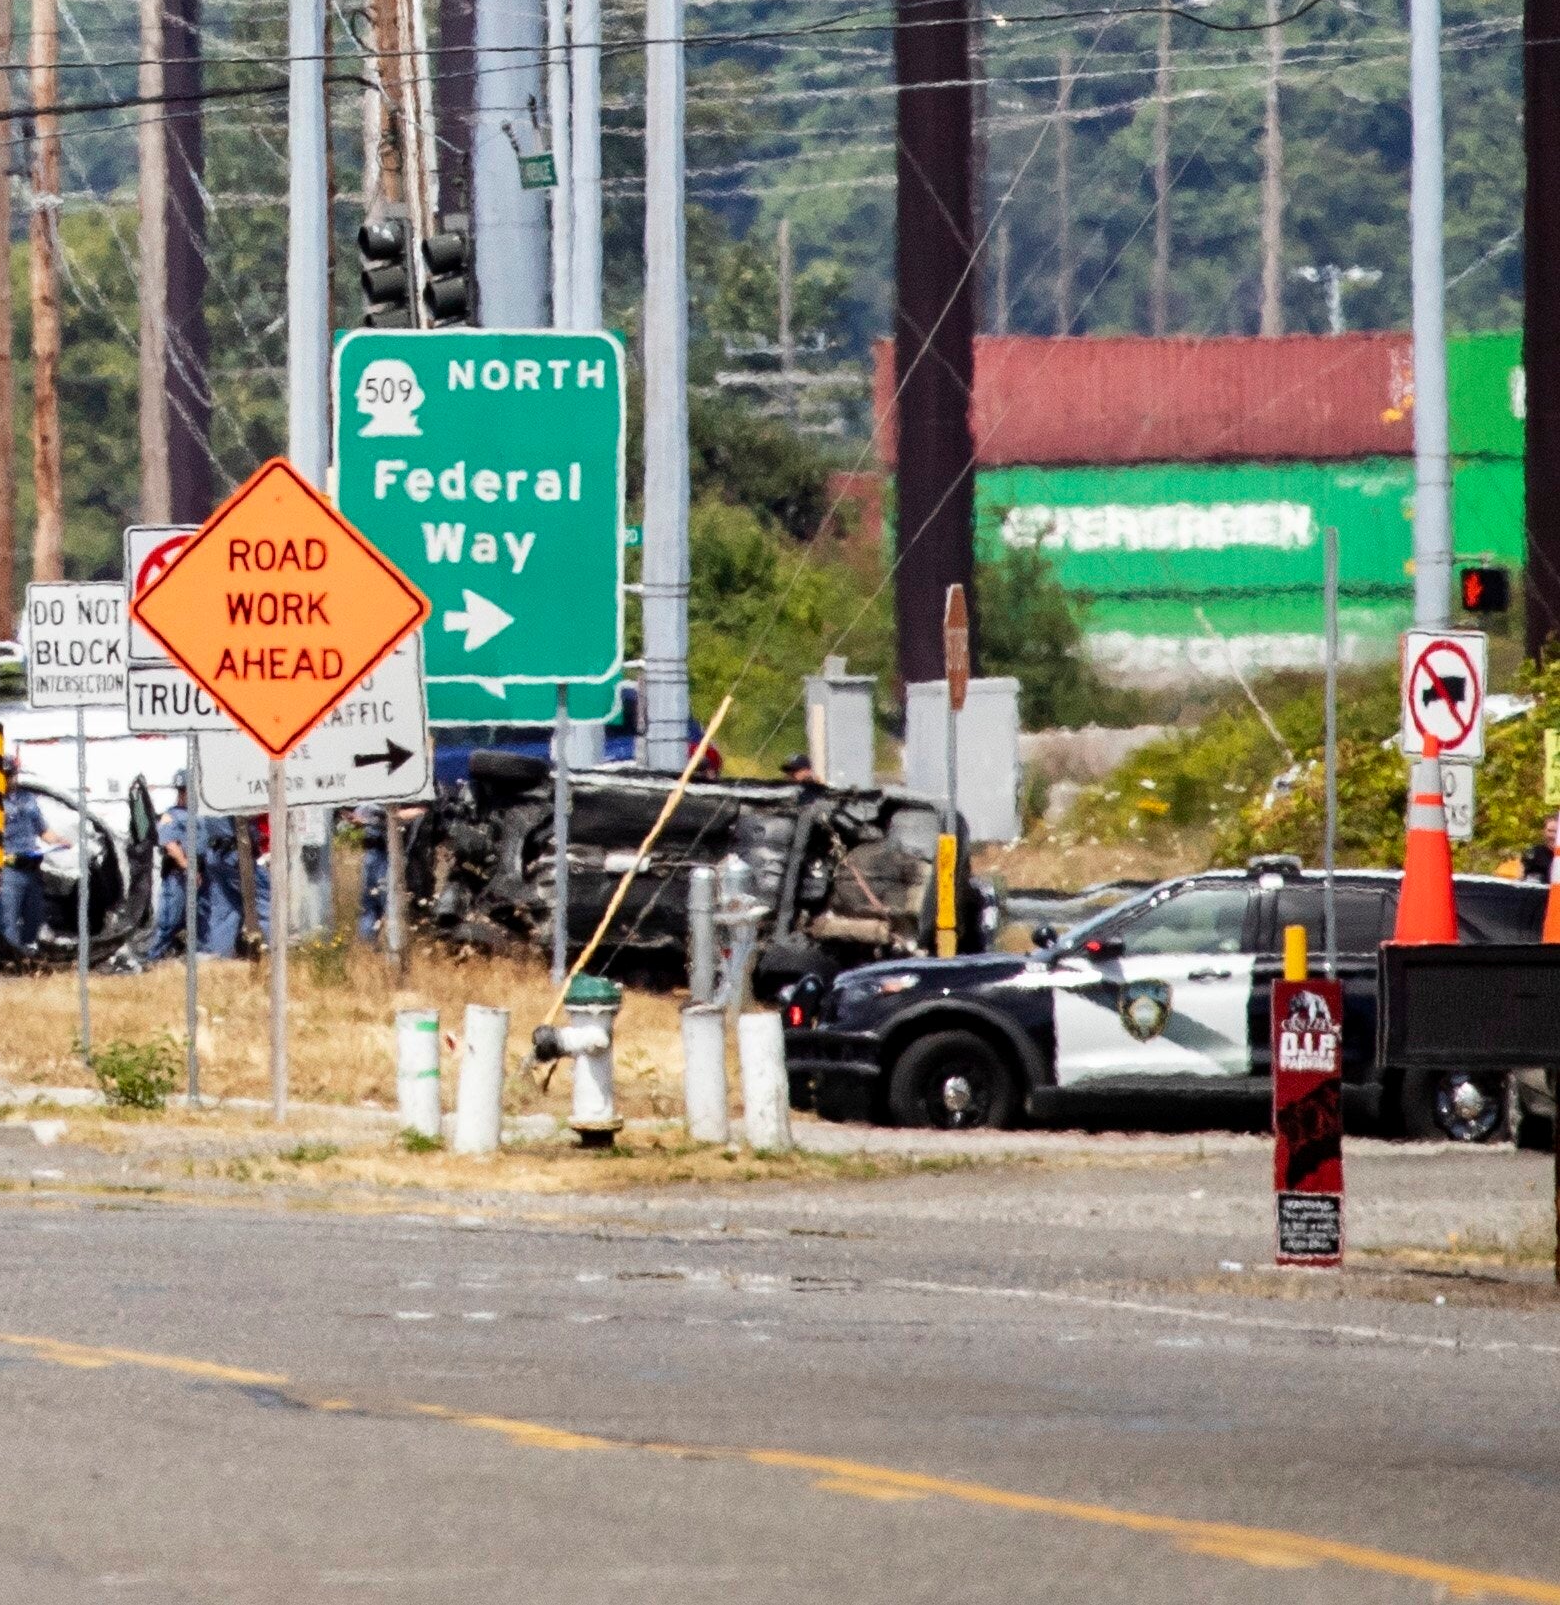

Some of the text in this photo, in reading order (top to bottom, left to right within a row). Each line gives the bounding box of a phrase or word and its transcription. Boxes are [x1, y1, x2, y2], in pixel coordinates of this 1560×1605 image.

[365, 358, 606, 404] 509 NORTH
[373, 458, 582, 503] Federal
[229, 537, 328, 572] ROAD
[420, 521, 537, 575] Way
[33, 598, 122, 626] DO NOT
[225, 592, 331, 626] WORK
[36, 637, 123, 667] BLOCK
[213, 647, 344, 681] AHEAD
[34, 673, 125, 694] INTERSECTION
[134, 682, 222, 717] TRUC
[322, 700, 395, 729] AFFIC
